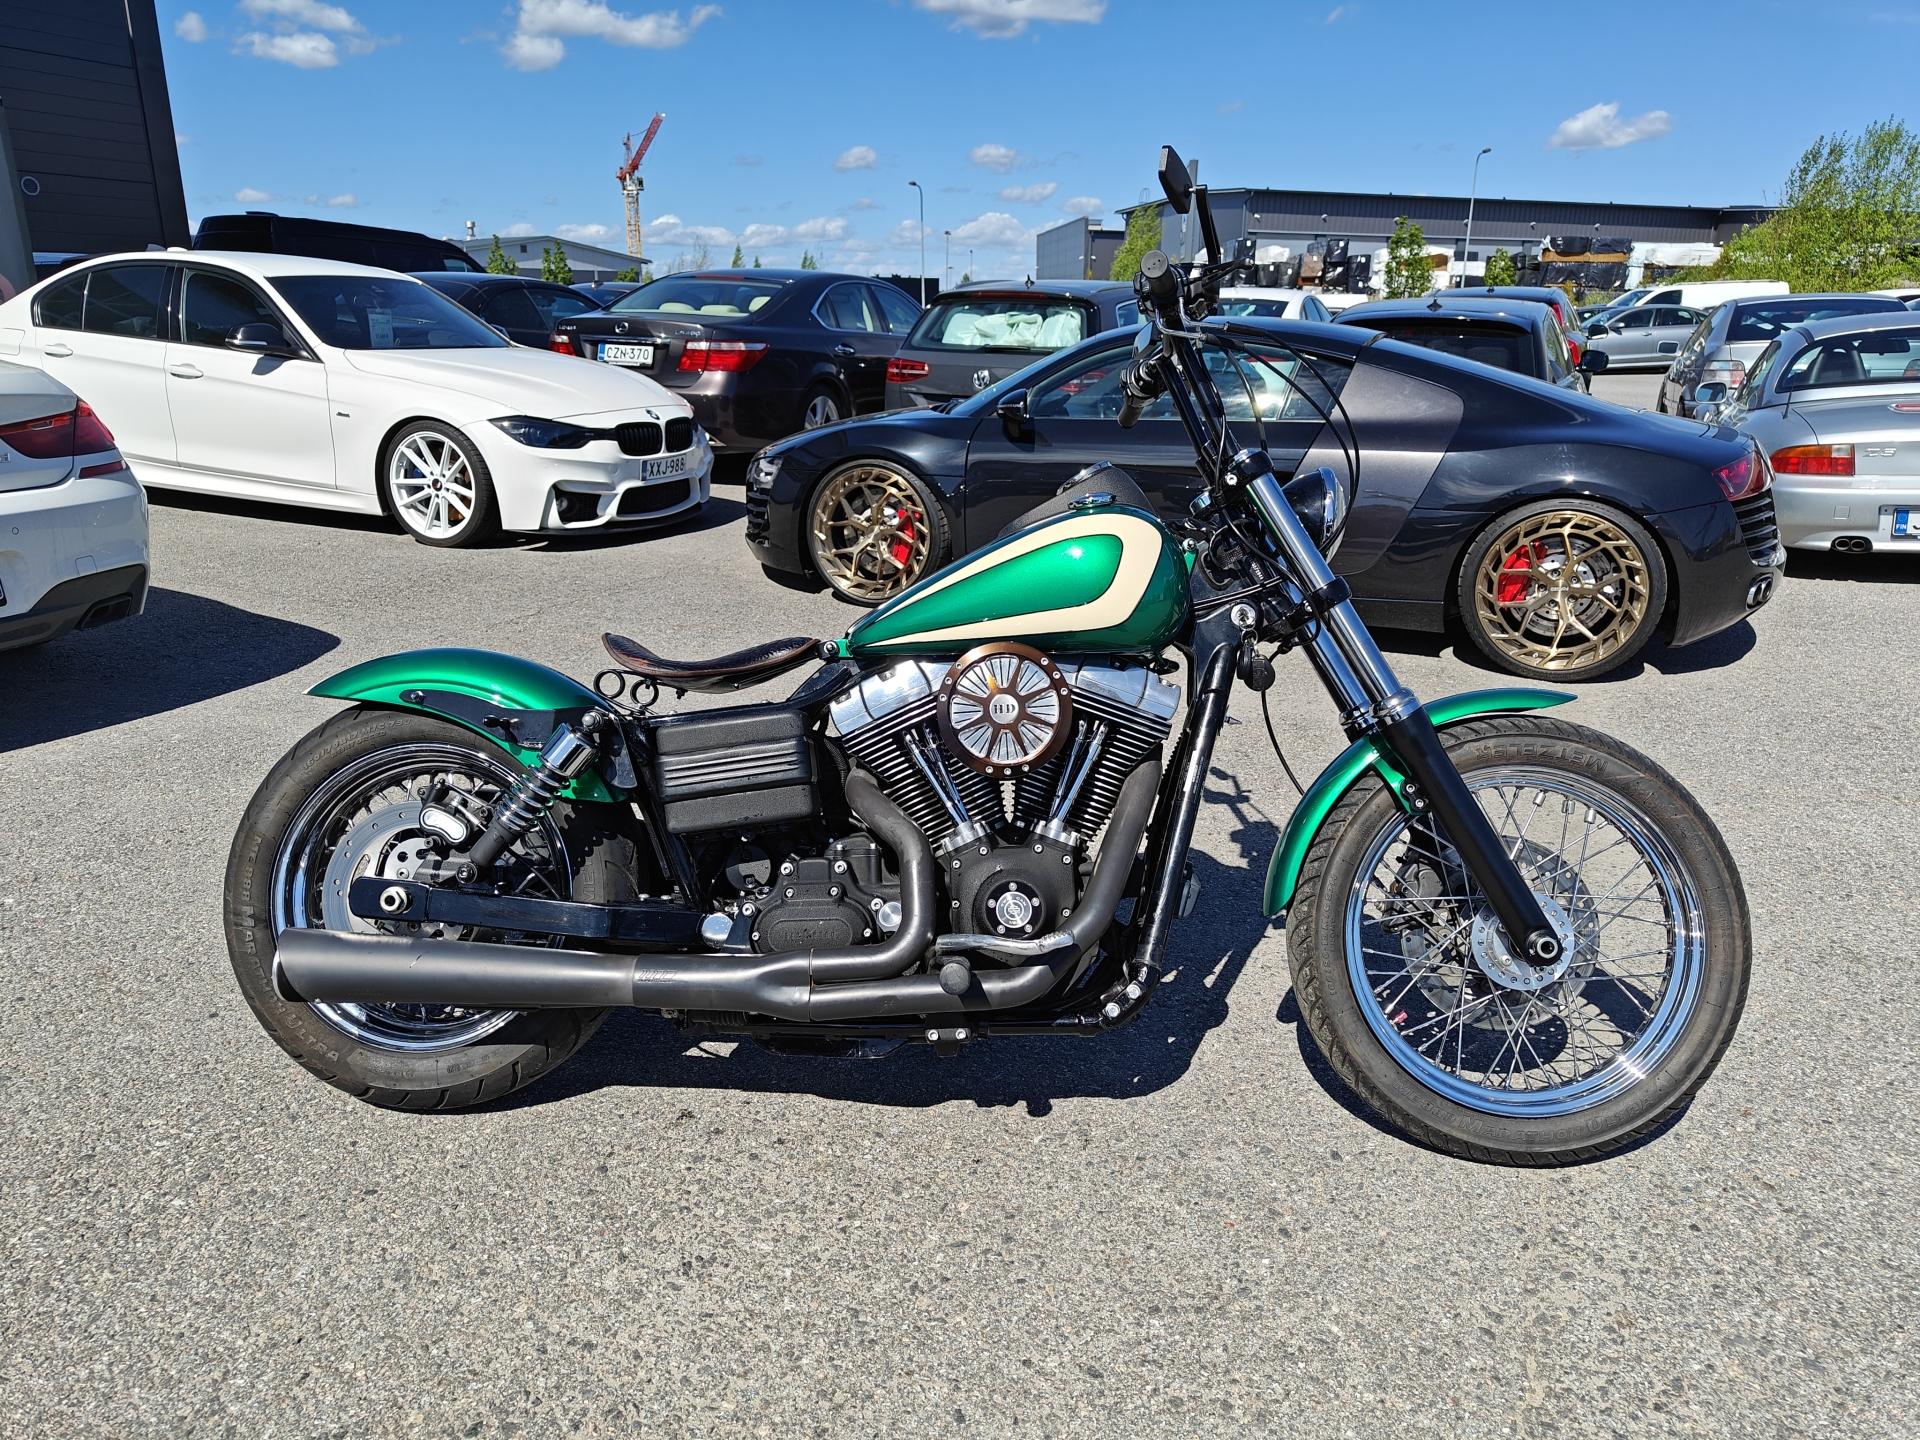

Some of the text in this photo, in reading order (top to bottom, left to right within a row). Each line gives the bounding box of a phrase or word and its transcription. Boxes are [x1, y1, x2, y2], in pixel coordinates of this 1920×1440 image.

[606, 346, 650, 361] CZN-370
[648, 457, 685, 478] XXJ-988
[1475, 743, 1609, 773] METZELER
